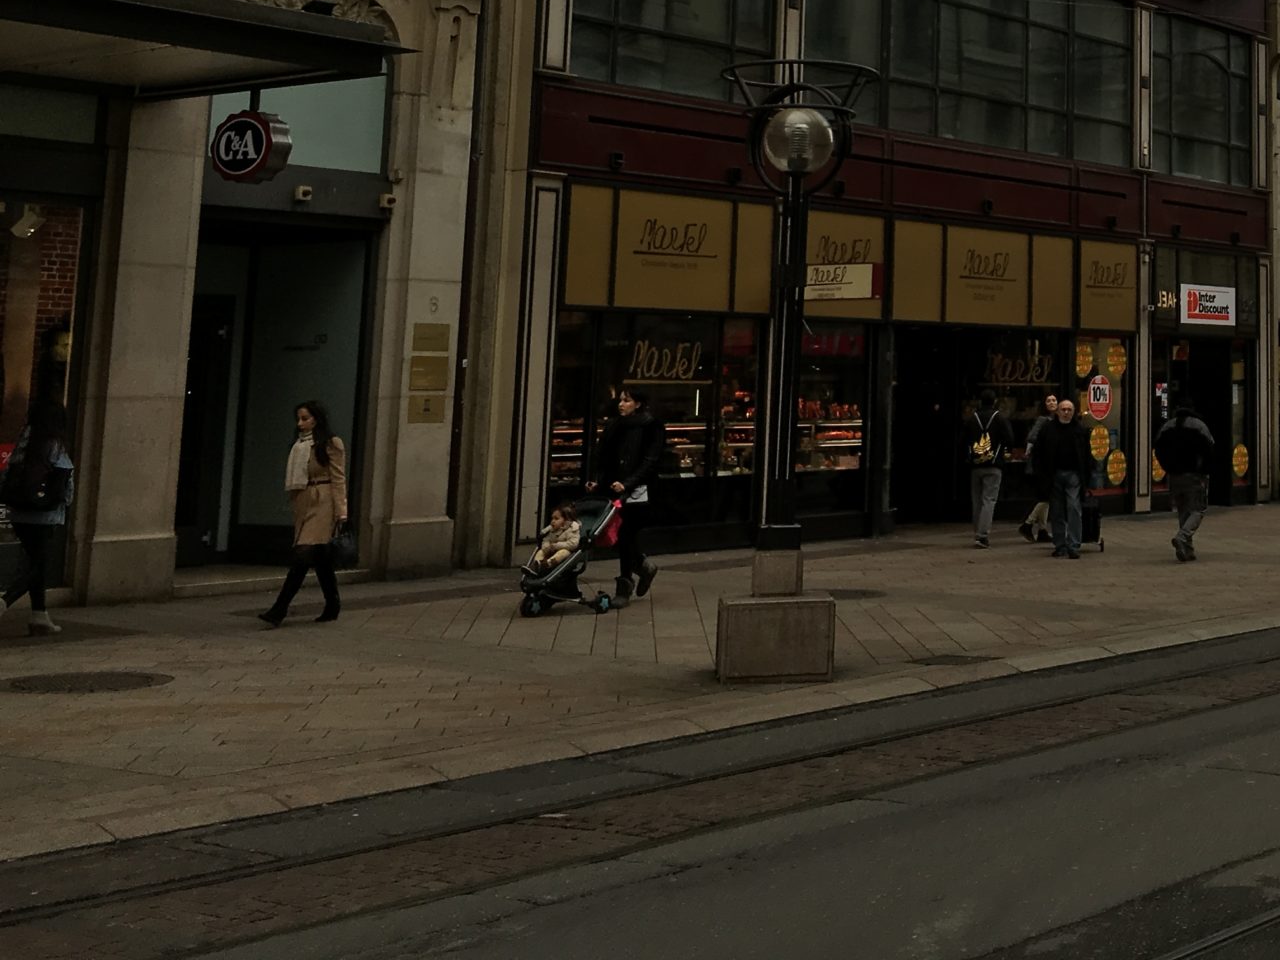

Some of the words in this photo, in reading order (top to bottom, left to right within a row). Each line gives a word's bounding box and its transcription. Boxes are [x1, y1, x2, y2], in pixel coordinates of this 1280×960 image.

[219, 130, 257, 161] C&A
[1199, 292, 1216, 303] Inter
[1198, 303, 1229, 315] Discount
